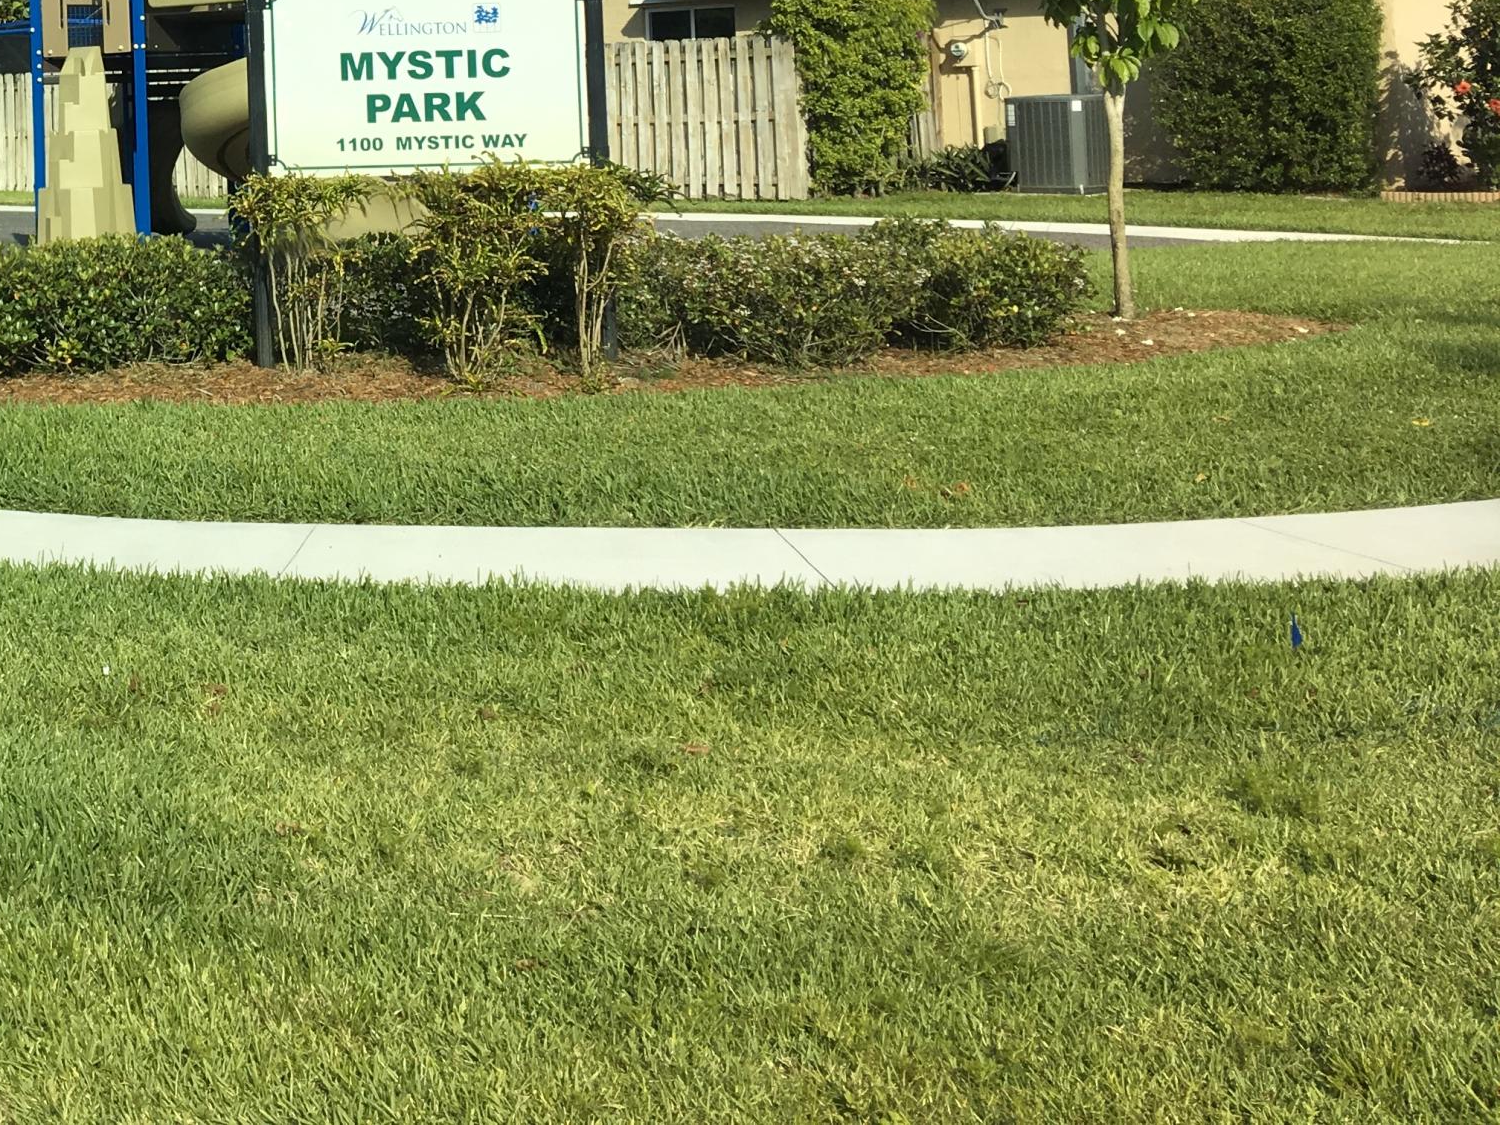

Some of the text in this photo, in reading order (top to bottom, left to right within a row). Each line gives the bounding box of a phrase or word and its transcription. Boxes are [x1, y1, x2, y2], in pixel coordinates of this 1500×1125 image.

[339, 48, 511, 82] MYSTIC
[366, 91, 487, 124] PARK
[336, 133, 528, 152] 1100 MYSTIC WAY
